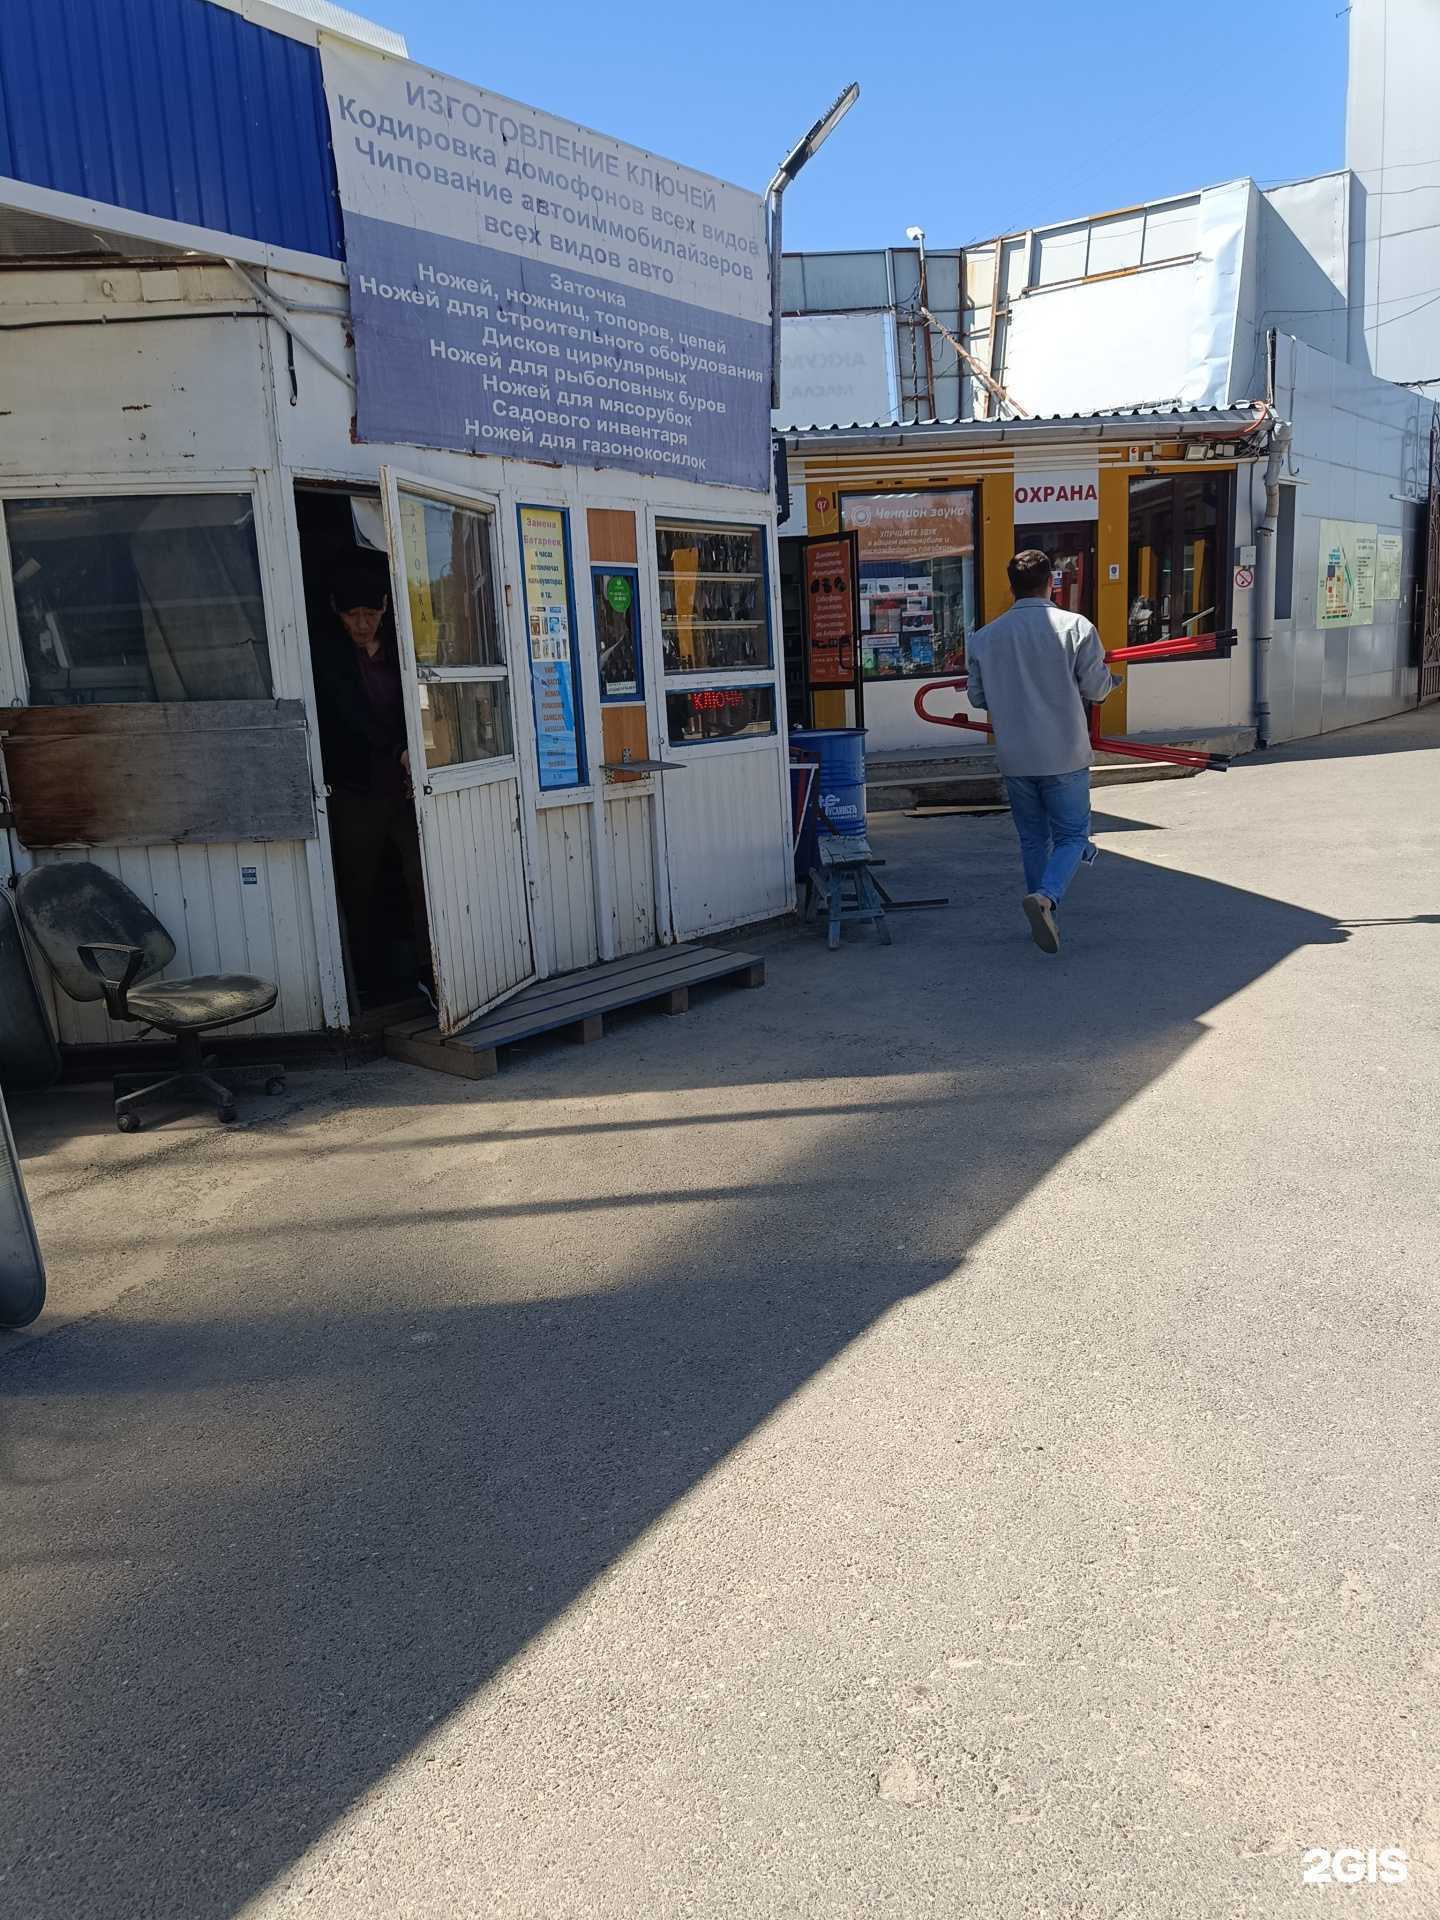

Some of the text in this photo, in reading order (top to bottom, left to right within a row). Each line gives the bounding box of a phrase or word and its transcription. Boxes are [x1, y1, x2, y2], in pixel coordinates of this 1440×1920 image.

[338, 94, 760, 255] Кодировка домофонов всех видов
[406, 81, 716, 212] ИЗГОТОВЛЕНИЕ КЛЮЧЕЙ
[354, 136, 753, 280] Чипование автоиммобилайзеров
[485, 215, 674, 284] всех видов авто
[418, 263, 727, 354] Ножей, ножниц, топоров, цепей
[549, 273, 626, 307] Заточка
[359, 275, 763, 384] Ножей для строительного оборудования
[482, 327, 688, 385] Дисков циркулярных
[430, 339, 727, 414] Ножей для рыболовных буров
[482, 374, 692, 427] Ножей для мясорубок
[464, 418, 707, 470] Ножей для газонокосилок
[493, 400, 688, 445] Садового инвентаря
[876, 505, 965, 519] Чемпион звука
[1014, 484, 1098, 503] ОХРАНА
